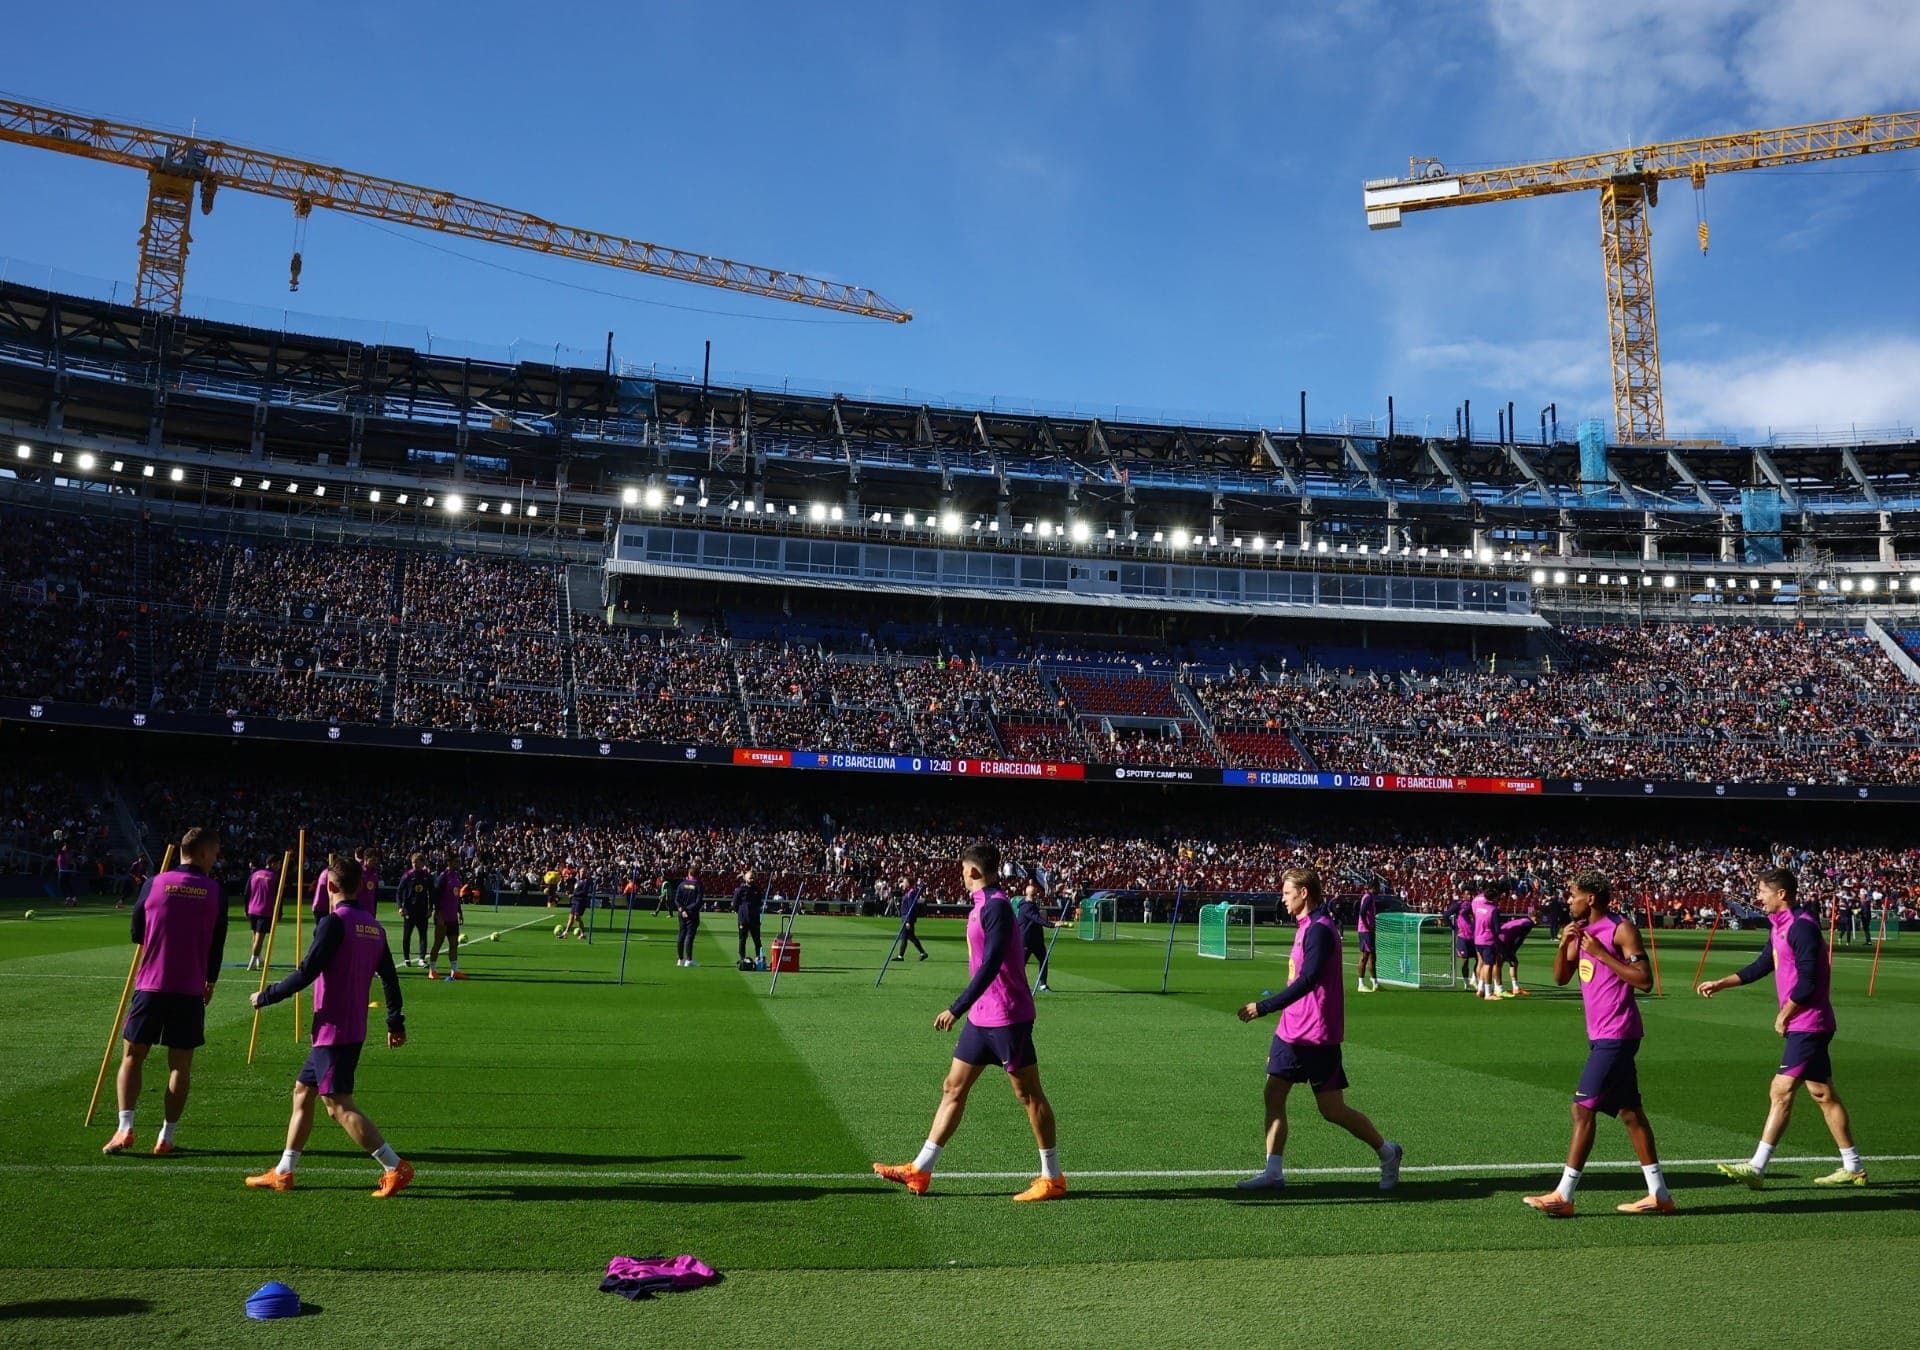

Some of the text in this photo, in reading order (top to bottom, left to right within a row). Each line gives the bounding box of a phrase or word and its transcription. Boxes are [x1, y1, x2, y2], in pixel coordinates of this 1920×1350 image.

[832, 755, 896, 770] FC BARCELONA
[912, 758, 921, 771] 0
[929, 760, 951, 772] 12:40
[958, 761, 967, 773] 0
[980, 762, 1042, 776] FC BARCELONA
[1126, 769, 1155, 778] SPOTIFY
[1156, 771, 1177, 779] CAMP
[1260, 772, 1319, 786] FC BARCELONA
[1333, 774, 1342, 787] 0
[1350, 775, 1370, 787] 12:40
[1375, 776, 1384, 788] 0
[1396, 777, 1453, 790] FC BARCELONA
